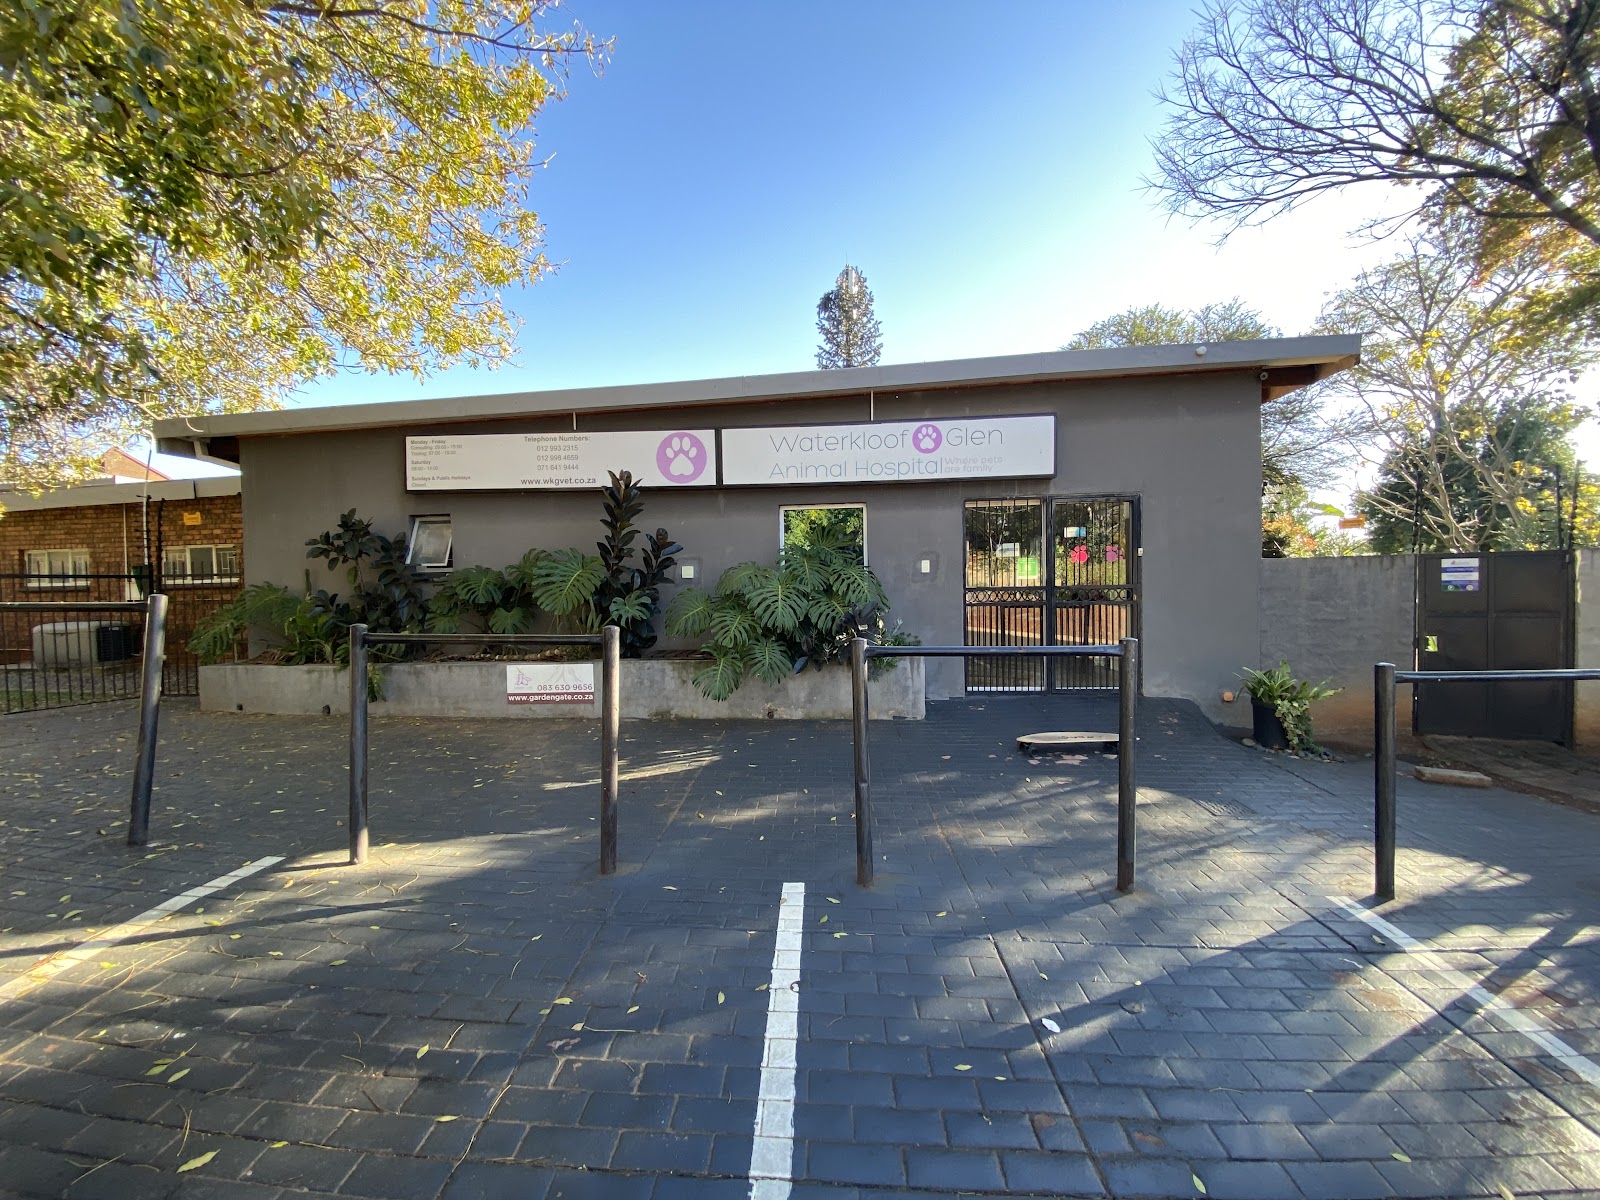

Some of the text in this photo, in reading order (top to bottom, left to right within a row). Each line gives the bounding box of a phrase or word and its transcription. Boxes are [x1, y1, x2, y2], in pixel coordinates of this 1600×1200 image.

[769, 427, 1003, 453] Waterkloof Glen
[944, 455, 1003, 466] Where pets
[769, 457, 943, 479] Animal Hospital
[944, 464, 993, 474] are family
[520, 477, 597, 486] www.wkgvet.co.za
[537, 684, 553, 692] 083
[572, 683, 593, 691] 9656
[508, 693, 593, 702] www.gardengate.co.za
